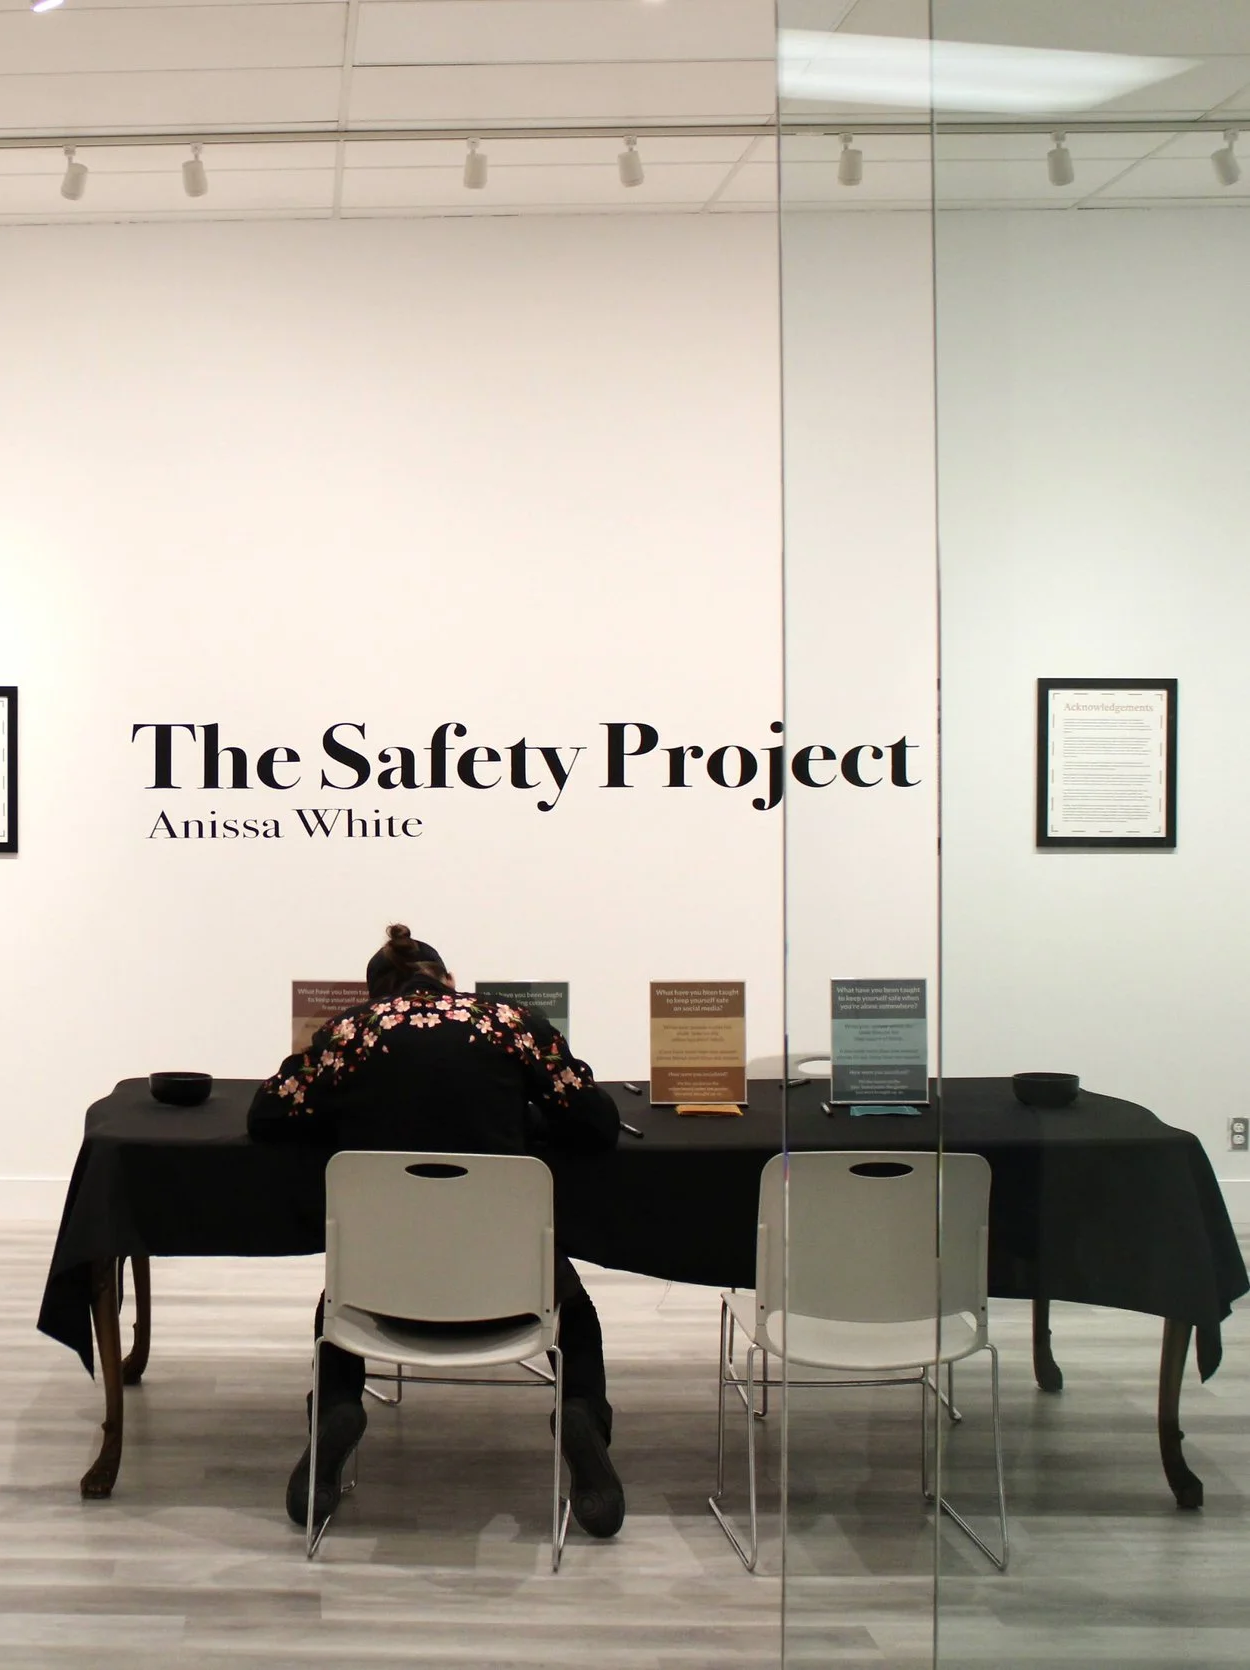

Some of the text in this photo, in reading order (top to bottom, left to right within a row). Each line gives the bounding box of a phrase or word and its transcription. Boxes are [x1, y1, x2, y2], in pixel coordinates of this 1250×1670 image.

[1063, 702, 1154, 714] Acknowledgements
[132, 721, 922, 812] The Safety Project
[146, 808, 424, 838] Anissa White
[543, 991, 562, 999] taught
[690, 990, 702, 998] you
[719, 989, 739, 997] taught
[900, 987, 920, 995] taught
[846, 995, 861, 1003] keep
